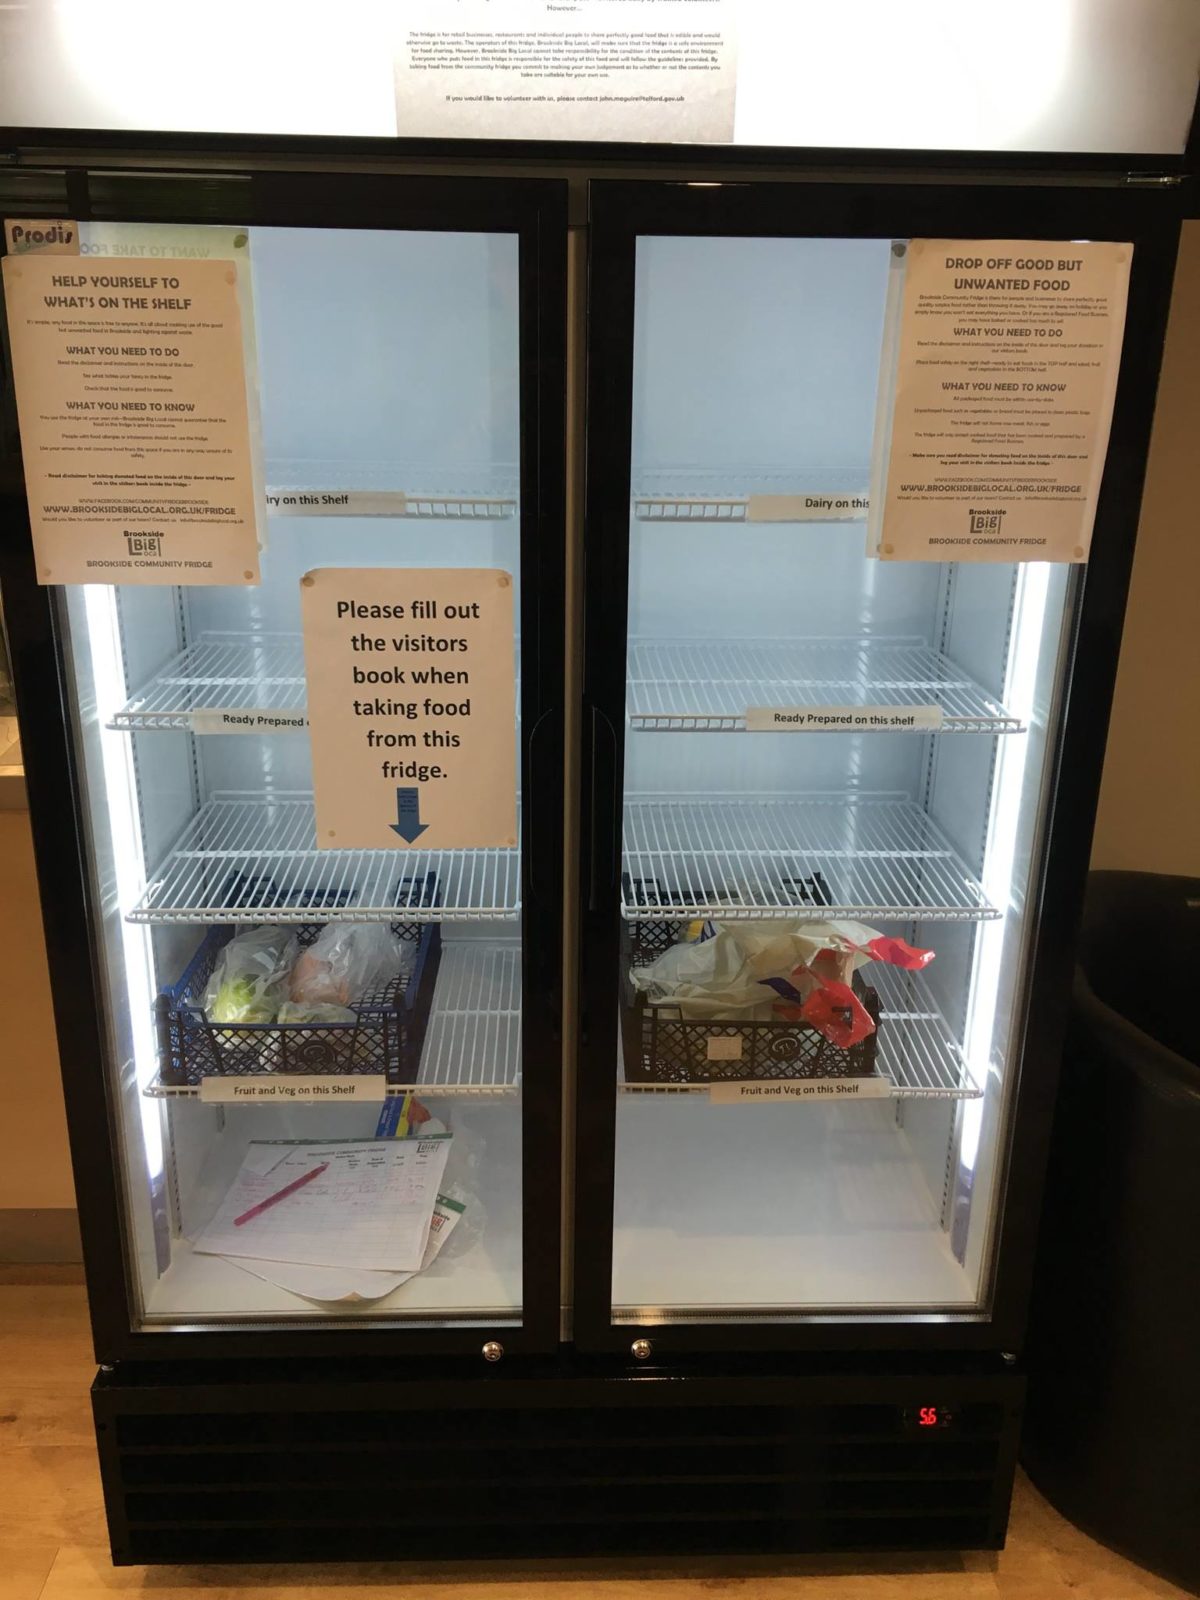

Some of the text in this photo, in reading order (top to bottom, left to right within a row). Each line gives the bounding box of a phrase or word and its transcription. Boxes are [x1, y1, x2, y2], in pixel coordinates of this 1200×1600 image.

[11, 226, 73, 244] Prodis
[945, 257, 1083, 271] DROP OFF GOOD BUT
[52, 275, 180, 289] HELP YOURSELF TO
[954, 278, 1070, 291] UNWANTED FOOD
[44, 296, 192, 310] WHAT'S ON THE SHELF
[954, 328, 1063, 338] WHAT YOU NEED TO DO
[66, 346, 180, 357] WHAT YOU NEED TO DO
[942, 382, 1067, 392] WHAT YOU NEED TO KNOW
[66, 401, 195, 412] WHAT YOU NEED TO KNOW
[900, 484, 1082, 493] WWW.BROOKSIDEBIGLOCAL.ORG.UK/FRIDGE
[266, 495, 280, 506] iry
[299, 495, 319, 504] this
[322, 495, 349, 504] Shelf
[805, 498, 833, 510] Dairy
[43, 505, 236, 515] WWW.BROOKSIDEBIGLOCAL.ORG.UK/FRIDGE
[86, 560, 133, 568] BROOKSIDE
[337, 600, 480, 619] Please fill out
[351, 633, 468, 652] the visitors
[353, 666, 469, 684] book when
[353, 698, 471, 720] taking food
[223, 714, 254, 726] Ready
[257, 716, 304, 727] Prepared
[774, 713, 805, 725] Ready
[807, 714, 852, 725] Prepared
[869, 715, 888, 725] this
[890, 716, 915, 726] shelf
[367, 730, 460, 747] from this
[382, 761, 447, 782] fridge.
[234, 1086, 256, 1095] Fruit
[258, 1086, 276, 1095] and
[278, 1086, 296, 1097] Veg
[312, 1085, 330, 1094] this
[332, 1085, 356, 1094] Shelf
[741, 1086, 762, 1095] Fruit
[764, 1085, 781, 1095] and
[783, 1085, 801, 1096] Veg
[817, 1085, 834, 1094] this
[836, 1084, 859, 1093] Shelf
